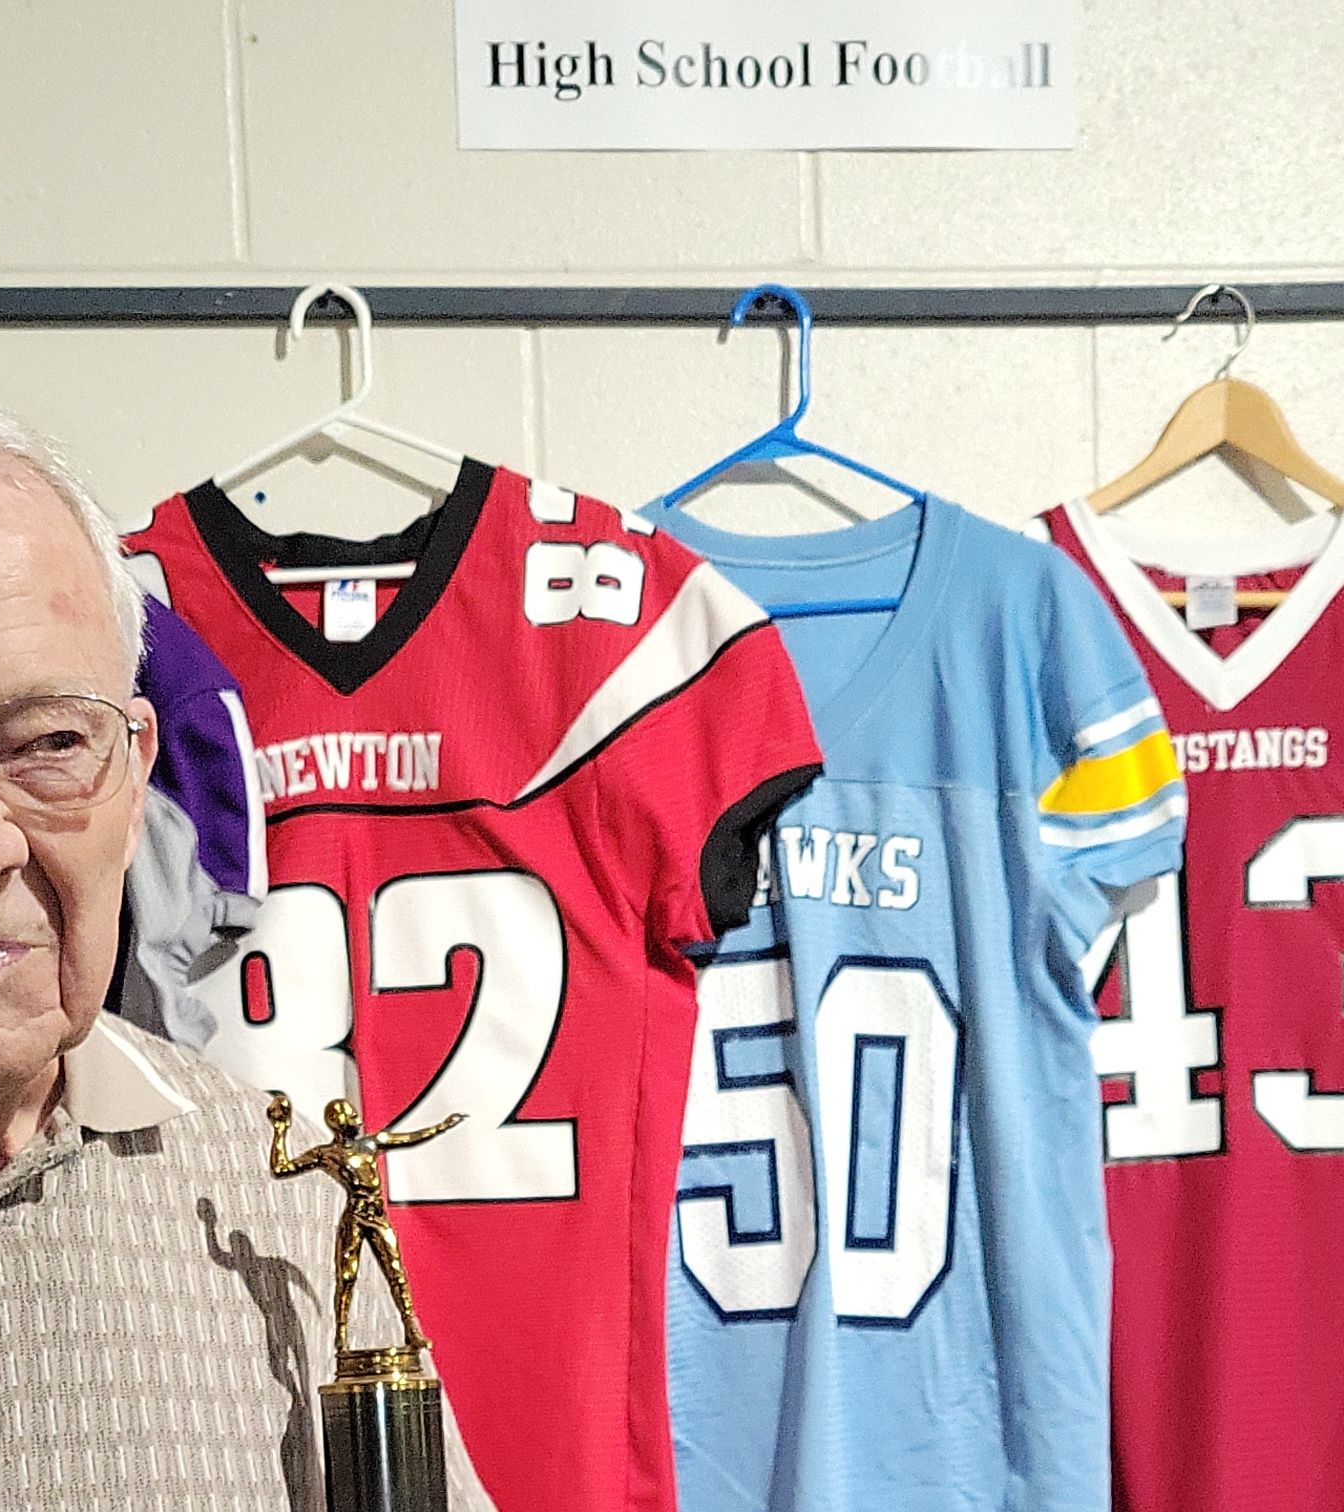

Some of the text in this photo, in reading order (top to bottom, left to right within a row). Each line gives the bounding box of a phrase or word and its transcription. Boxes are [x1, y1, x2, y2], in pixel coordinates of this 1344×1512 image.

[485, 40, 614, 99] High
[636, 39, 812, 88] School
[252, 731, 442, 802] NEWTON
[191, 868, 579, 1205] 82
[677, 952, 967, 1330] 50
